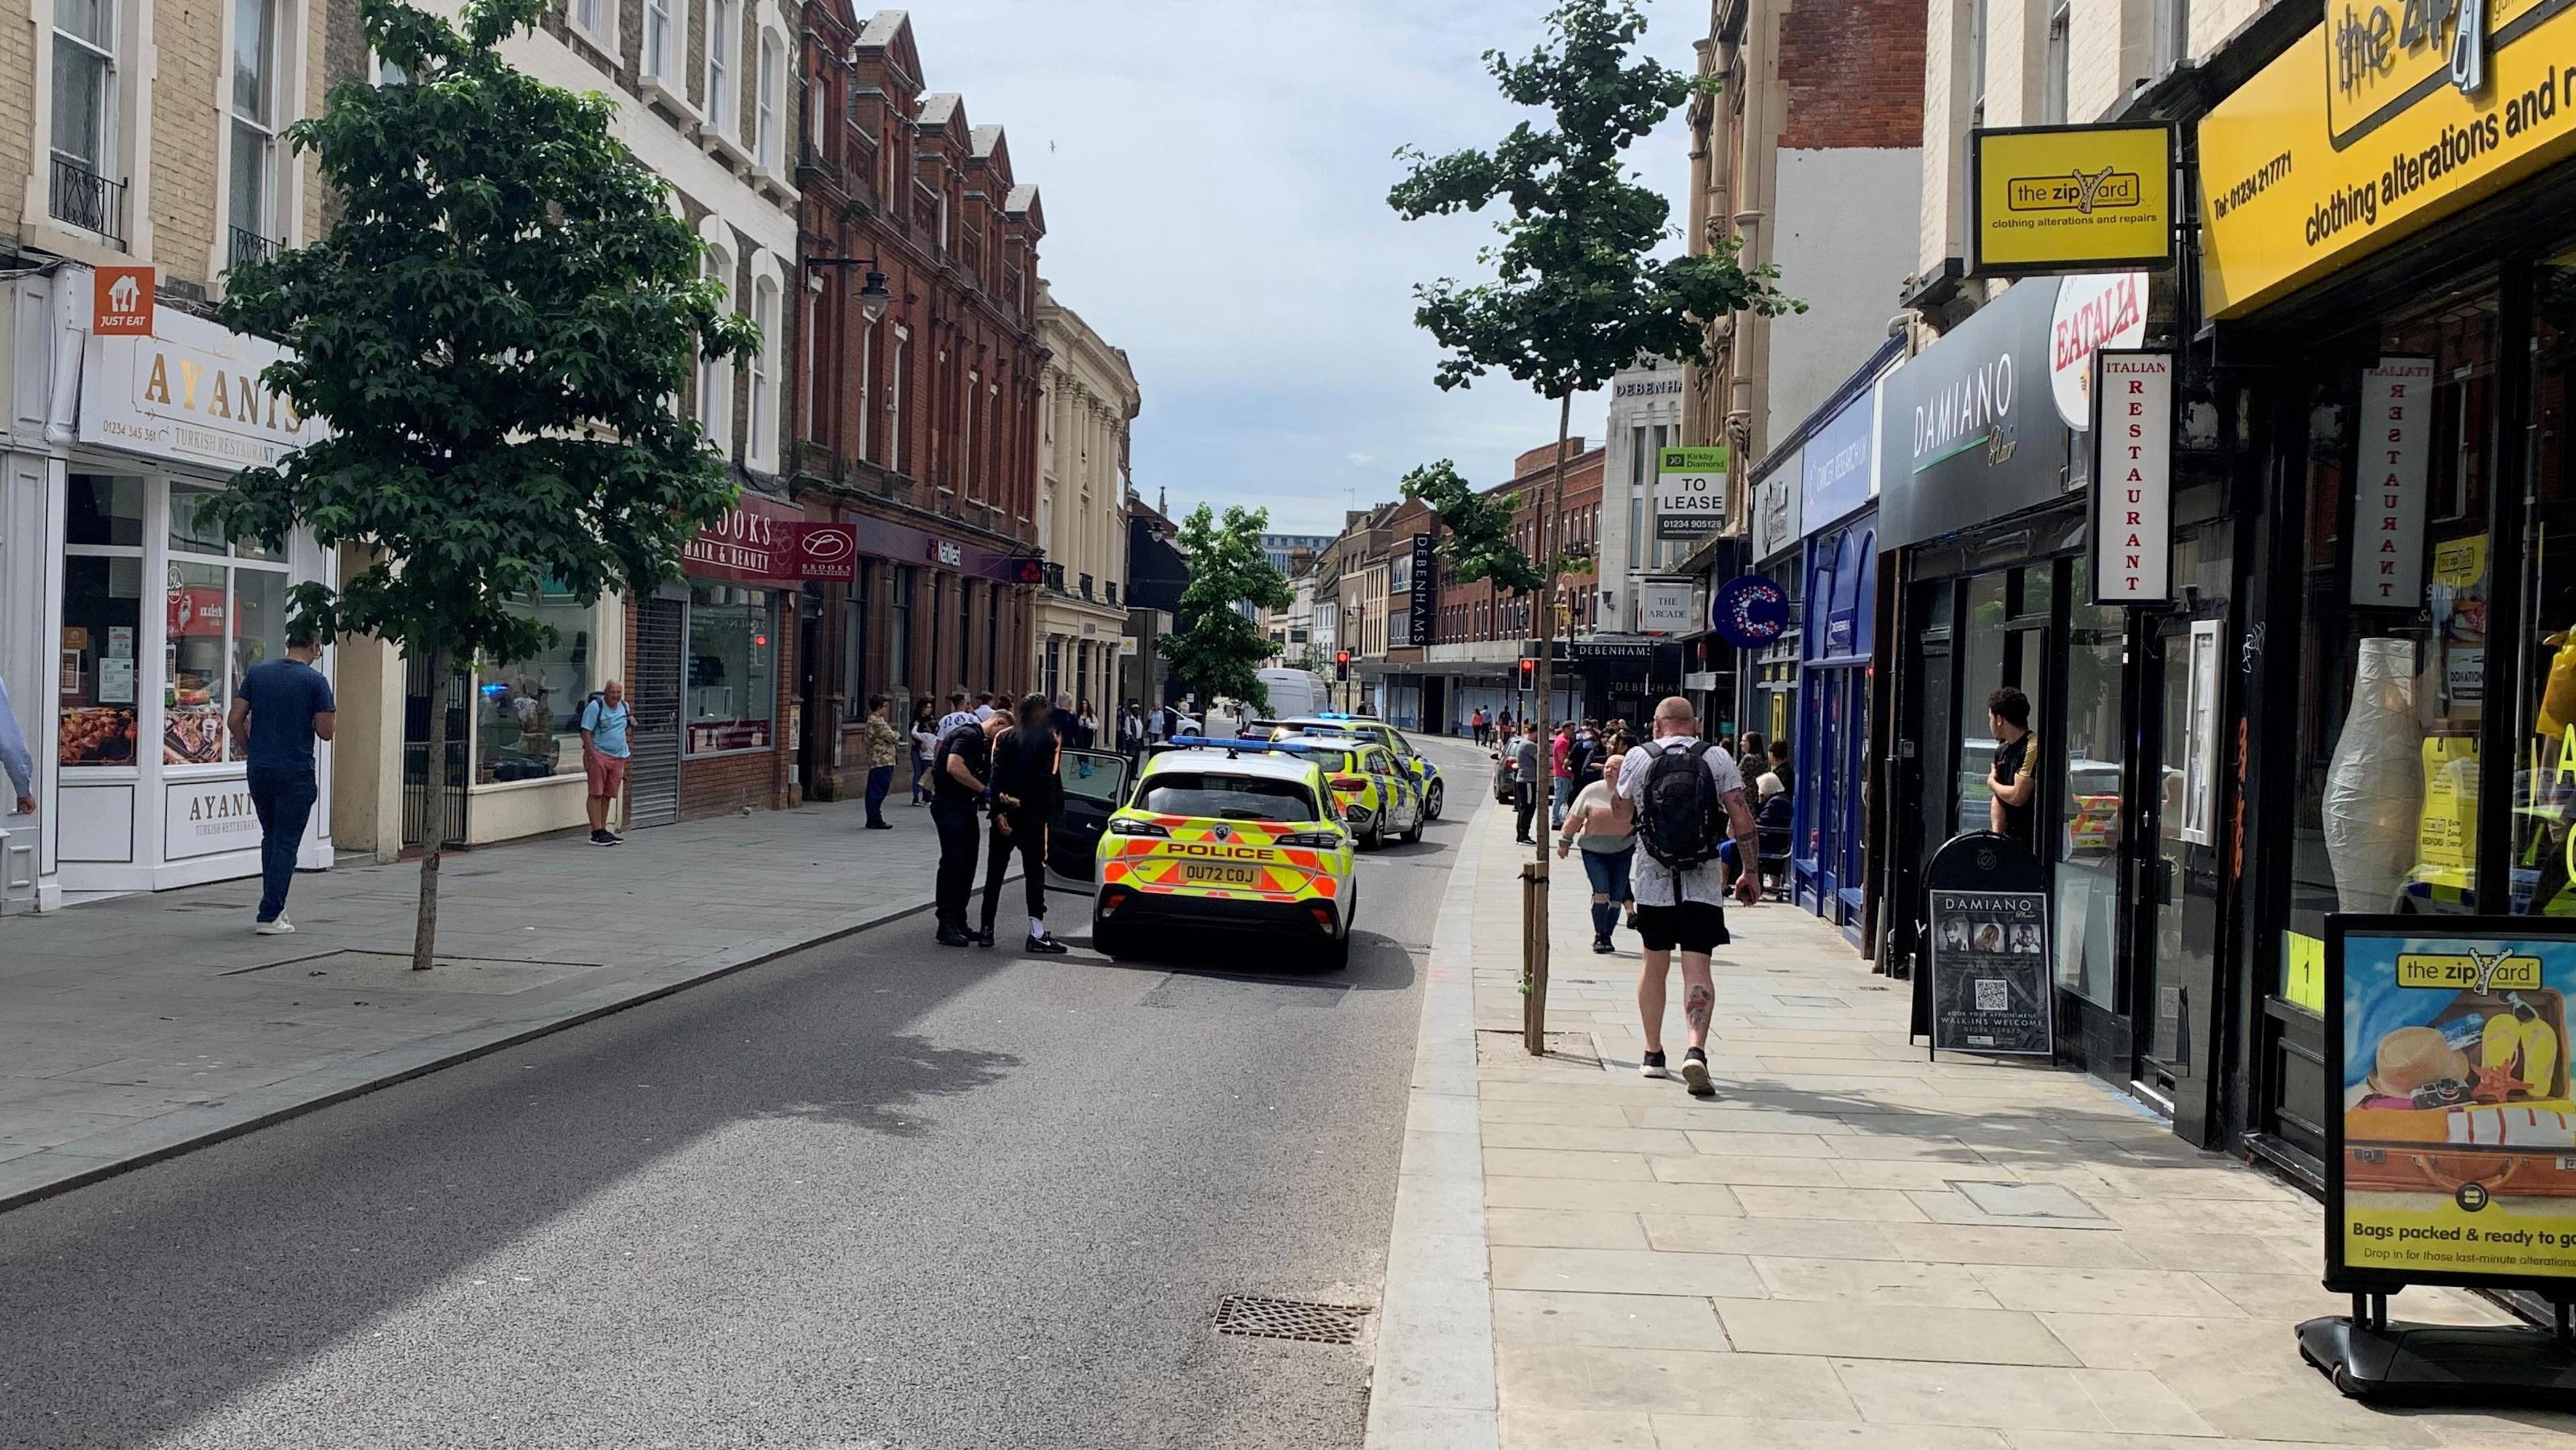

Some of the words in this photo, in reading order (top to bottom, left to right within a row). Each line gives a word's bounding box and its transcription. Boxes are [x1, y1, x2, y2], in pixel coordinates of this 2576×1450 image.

[2306, 181, 2377, 246] clothing
[2381, 113, 2499, 206] alterations
[2506, 65, 2555, 138] and
[2214, 196, 2229, 220] Tel:
[2231, 176, 2257, 211] 01234
[2258, 149, 2292, 192] 217771
[2018, 185, 2047, 201] the
[1992, 219, 2035, 229] clothing
[2037, 215, 2094, 226] alterations
[2097, 214, 2116, 223] and
[2120, 213, 2157, 224] repairs
[101, 315, 125, 327] JUST
[126, 315, 146, 326] EAT
[2056, 272, 2140, 372] EATALIA
[2106, 362, 2166, 374] ITALIAN
[145, 353, 303, 435] AYANIS
[1914, 352, 2012, 458] DAMIANO
[103, 419, 126, 435] 01234
[175, 427, 217, 450] TURKISH
[218, 436, 274, 464] RESTAURANT
[1687, 453, 1713, 461] Kirkby
[1682, 478, 1706, 491] TO
[2125, 380, 2144, 592] RESTAURANT
[1665, 496, 1723, 509] LEASE
[1664, 520, 1689, 528] 01234
[1691, 520, 1722, 528] 905128
[684, 539, 713, 560] HAIR
[719, 546, 726, 563] &
[732, 548, 769, 570] BEAUTY
[938, 540, 961, 567] NatWest
[802, 563, 851, 571] BROOKS
[1413, 537, 1428, 643] DEBENHAMS
[1658, 597, 1679, 605] THE
[1648, 610, 1686, 619] ARCADE
[1579, 645, 1652, 656] DEBENHAMS
[1615, 682, 1682, 694] DEBEHA
[189, 792, 252, 821] AYANI
[196, 822, 221, 837] TURKISH
[222, 819, 258, 833] RESTAURANT
[1167, 843, 1275, 860] POLICE
[1187, 865, 1223, 880] OU72
[1945, 898, 2031, 911] DAMIANO
[2304, 960, 2310, 984] 1
[2406, 960, 2438, 980] the
[1993, 1019, 2043, 1027] WELCOME
[2353, 1223, 2394, 1241] Bags
[2399, 1225, 2461, 1241] packed
[2466, 1228, 2479, 1242] &
[2484, 1229, 2534, 1247] ready
[2538, 1231, 2555, 1245] to
[2365, 1247, 2390, 1261] Drop
[2394, 1249, 2402, 1259] in
[2406, 1249, 2420, 1260] for
[2424, 1250, 2453, 1262] those
[2455, 1252, 2516, 1265] last-minute
